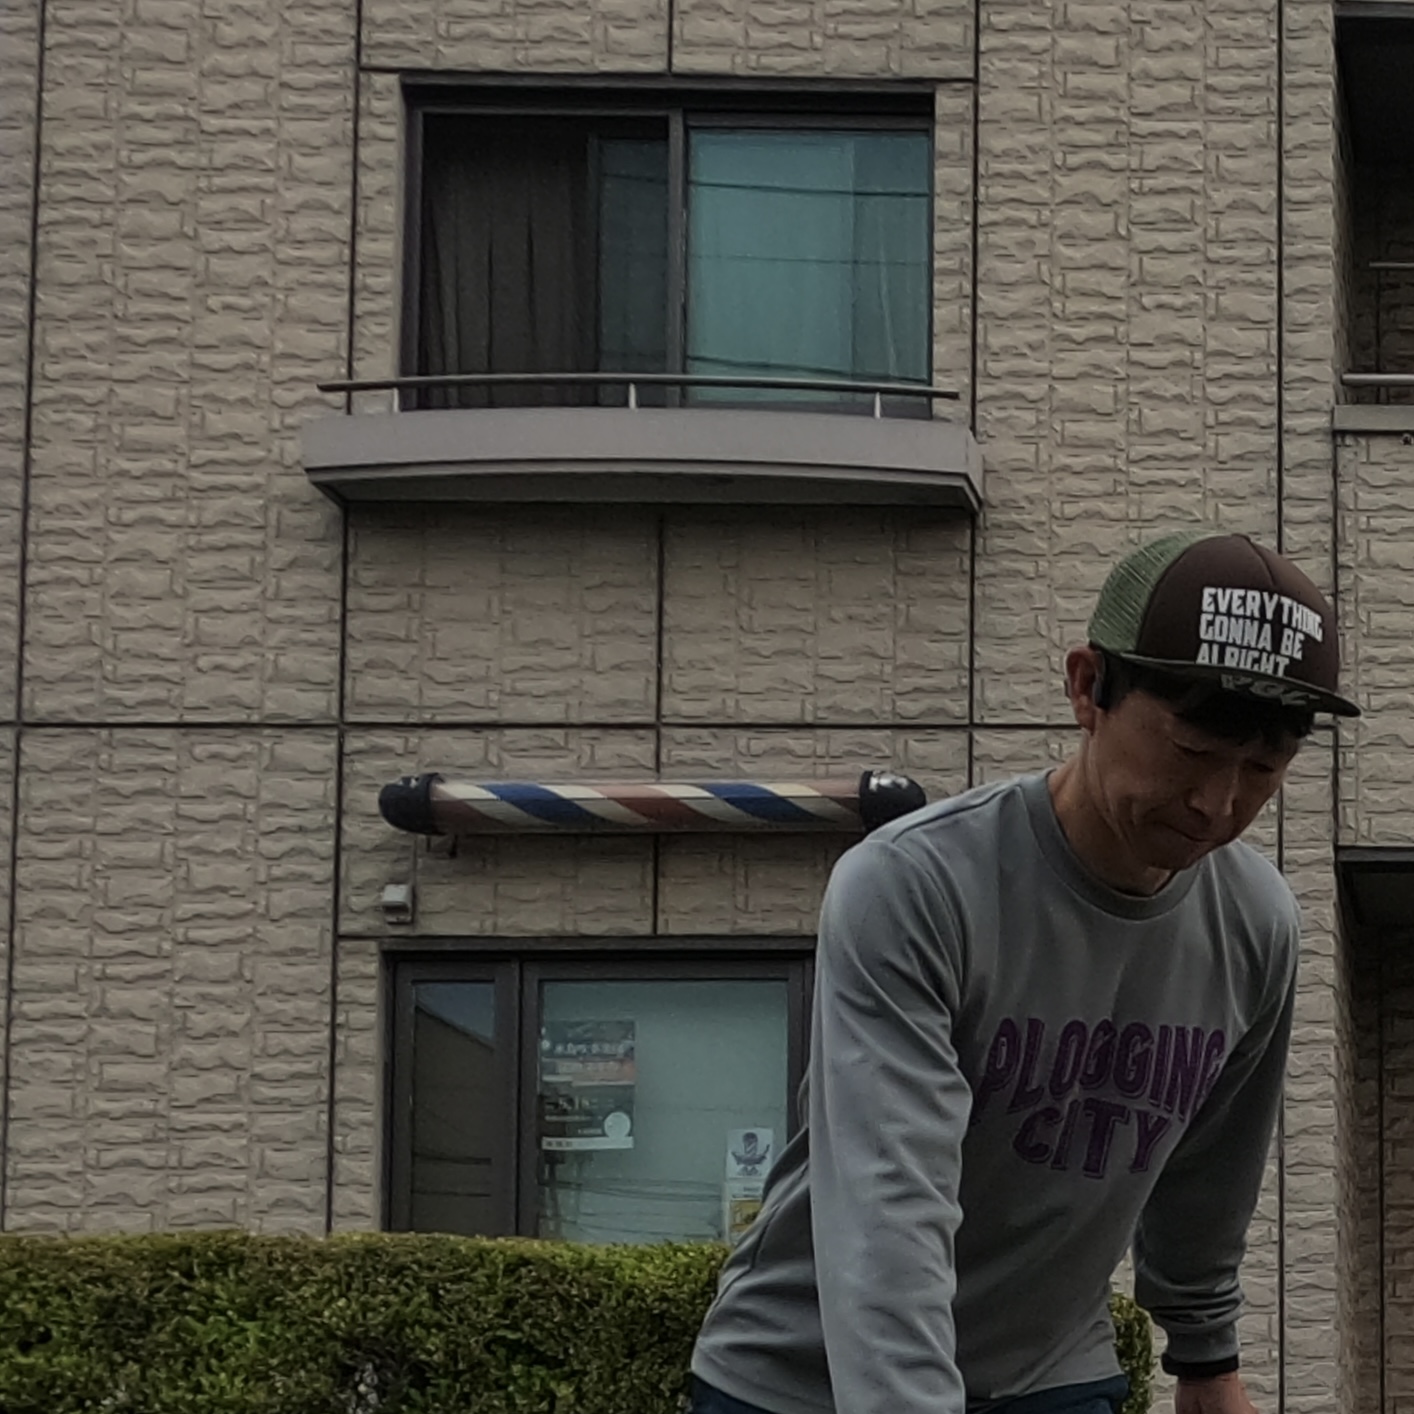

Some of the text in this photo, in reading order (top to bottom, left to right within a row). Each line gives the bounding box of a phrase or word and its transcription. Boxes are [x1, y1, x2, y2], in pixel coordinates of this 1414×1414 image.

[1199, 613, 1306, 661] GONNA BE
[1201, 586, 1324, 642] EVERYTHING
[1197, 643, 1290, 677] ALRIGHT
[973, 1017, 1226, 1124] PLOGGING
[1012, 1098, 1172, 1179] CITY
